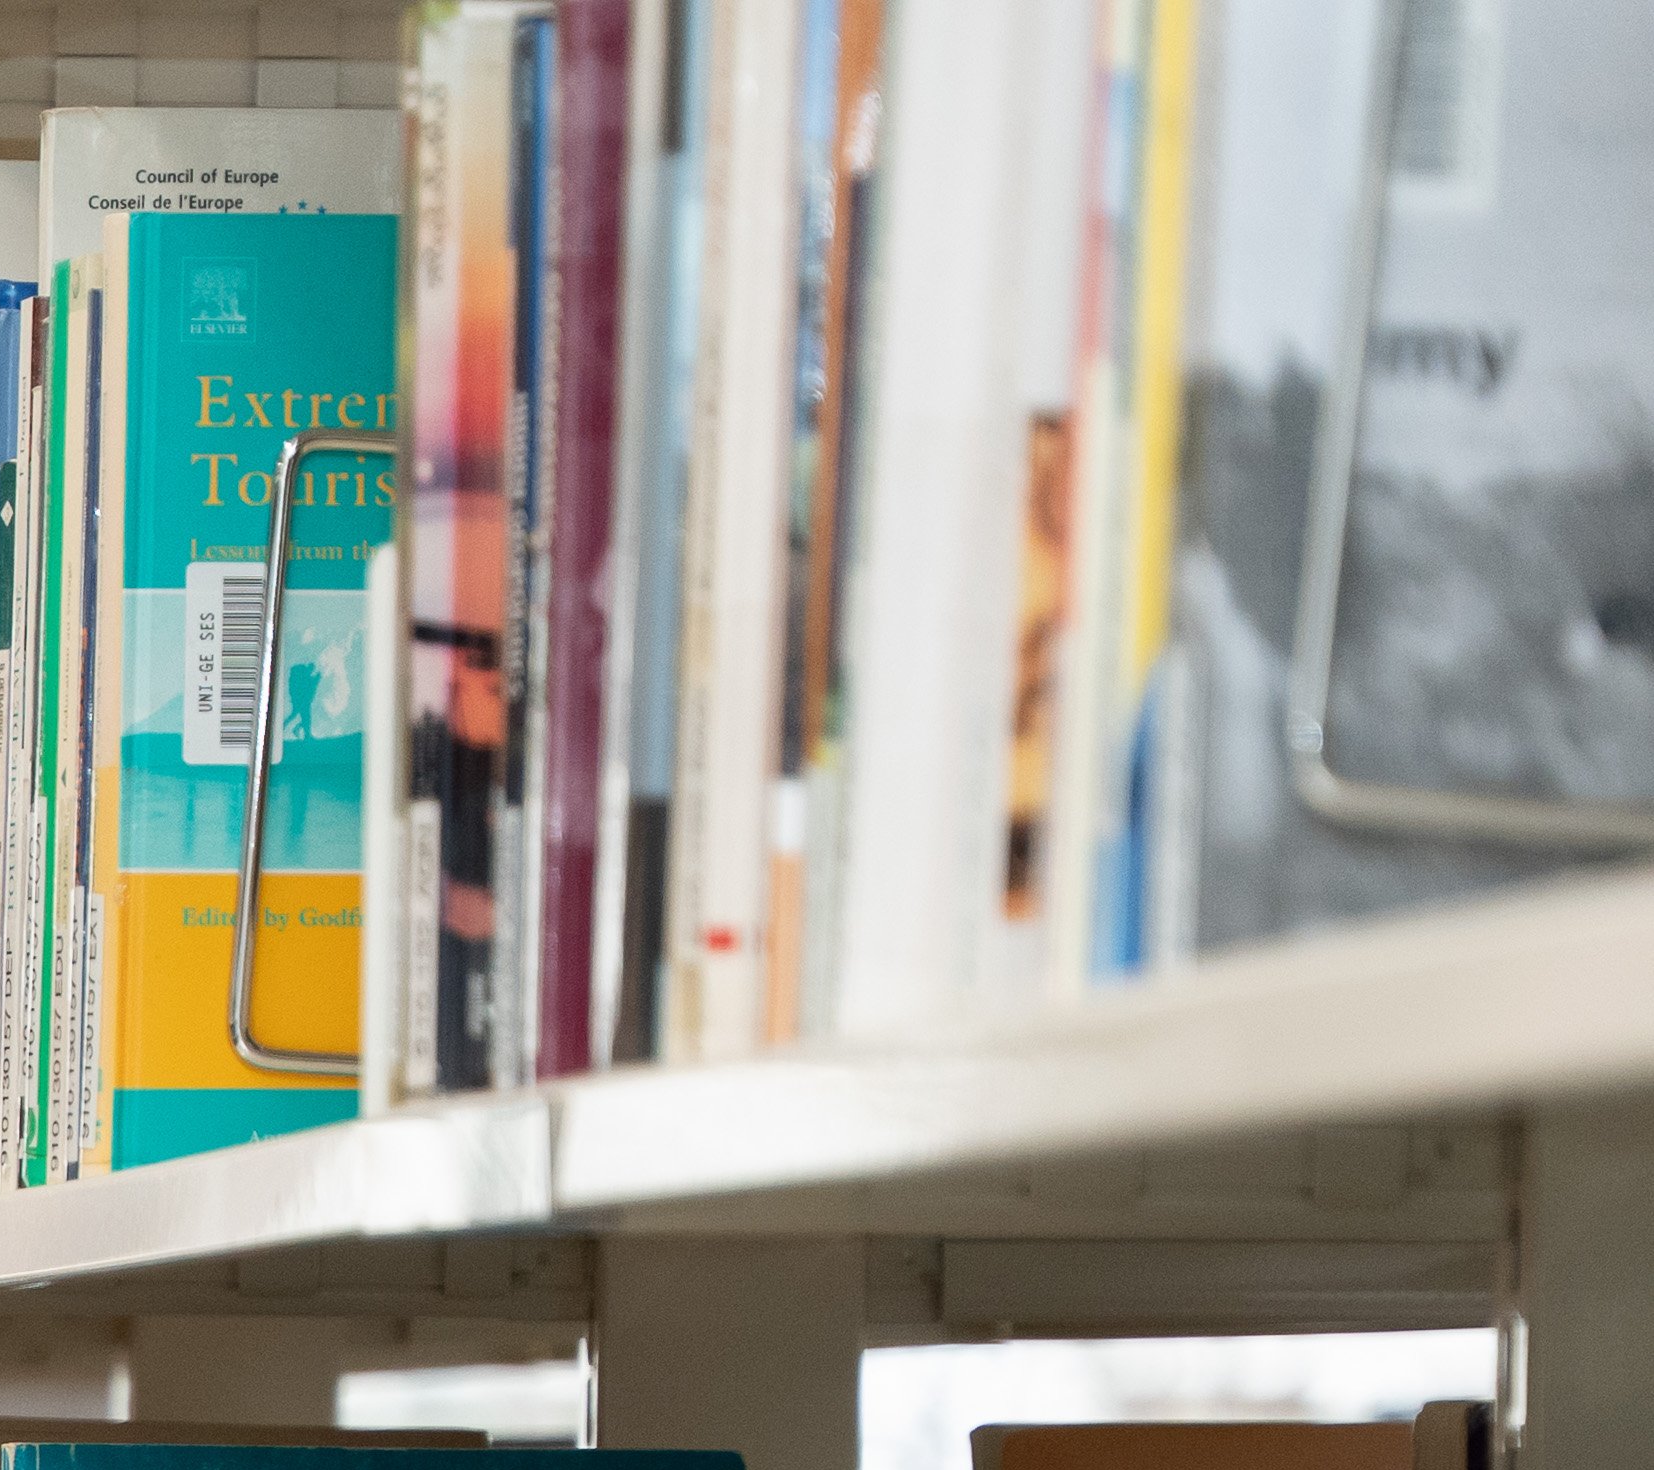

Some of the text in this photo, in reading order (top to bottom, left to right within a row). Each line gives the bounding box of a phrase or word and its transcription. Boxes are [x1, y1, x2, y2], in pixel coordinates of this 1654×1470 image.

[88, 194, 244, 213] Conseil de l'Europe
[135, 169, 279, 188] Council of Europe
[190, 324, 248, 335] ELSEVIER
[195, 611, 216, 712] UNI-GE SES
[4, 752, 20, 913] TOURISME
[182, 906, 289, 931] Edite by
[3, 935, 15, 997] DEP
[53, 933, 65, 997] EDU
[80, 900, 100, 1138] 910.130157 EXT
[46, 1007, 66, 1171] 910.130157
